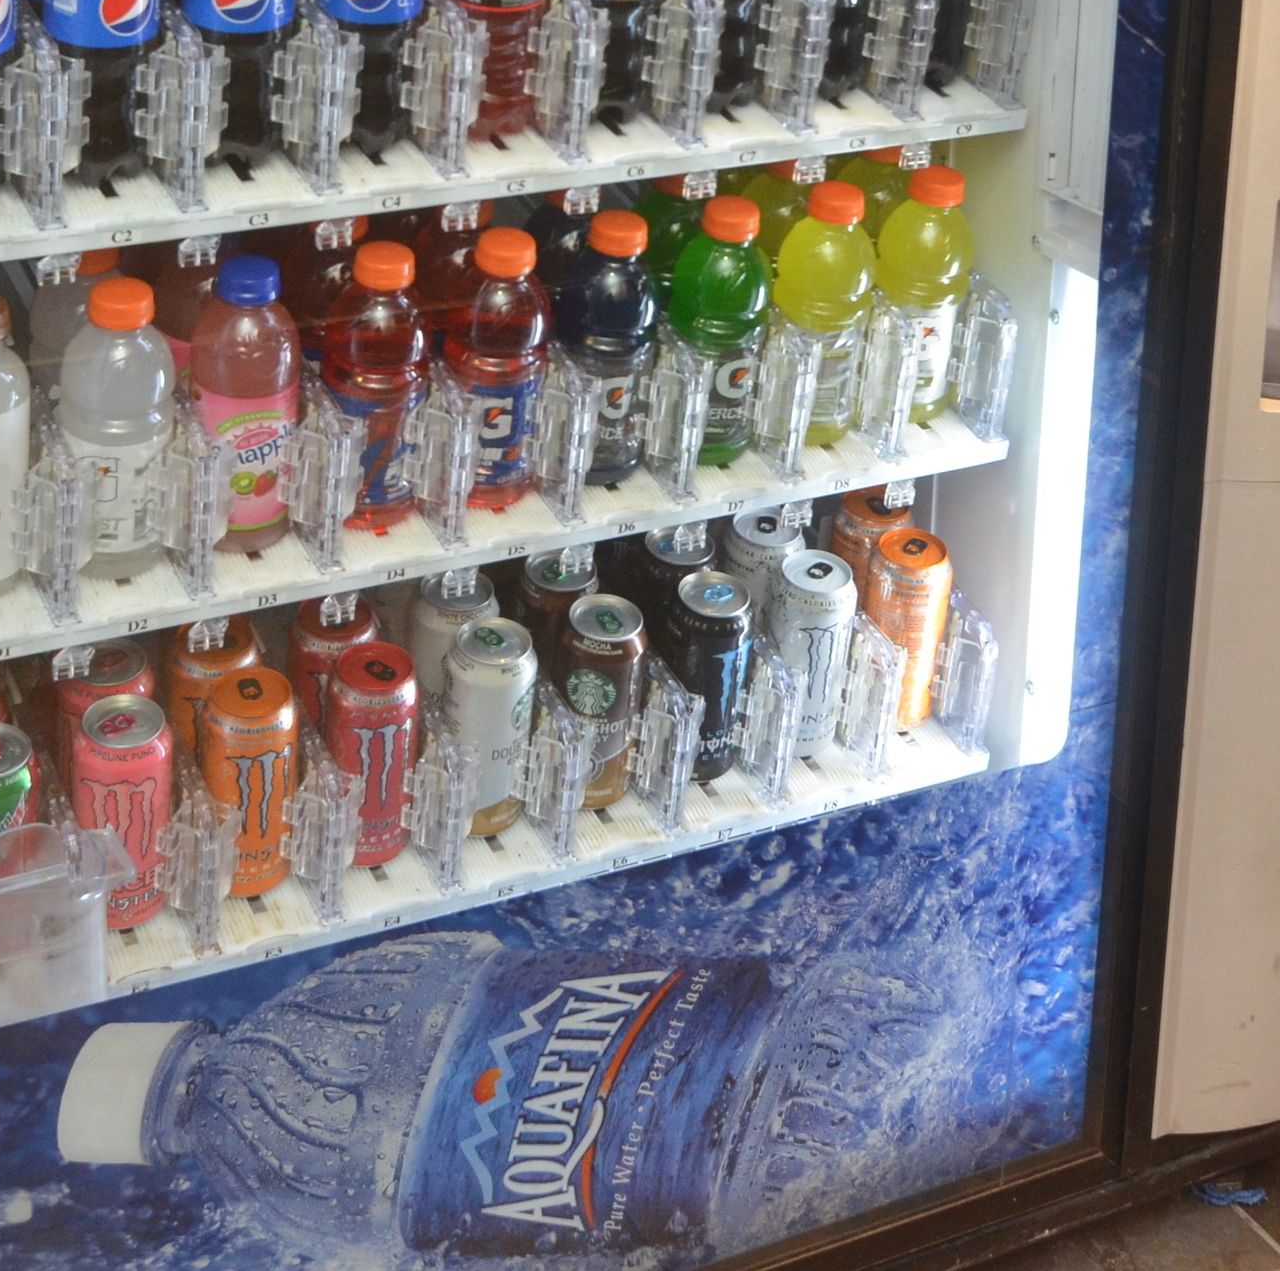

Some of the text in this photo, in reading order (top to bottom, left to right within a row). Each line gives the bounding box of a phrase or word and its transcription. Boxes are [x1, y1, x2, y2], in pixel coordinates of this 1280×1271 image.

[955, 123, 974, 136] C9
[848, 136, 867, 150] C8
[738, 149, 758, 163] C7
[626, 164, 646, 178] C6
[505, 180, 526, 193] C5
[381, 195, 402, 209] C4
[248, 213, 270, 227] C3
[110, 230, 133, 243] C2
[598, 374, 634, 420] G
[480, 397, 514, 440] G
[833, 479, 851, 491] D8
[727, 500, 745, 512] D7
[618, 520, 637, 533] D6
[385, 568, 407, 582] D4
[257, 594, 279, 608] D3
[127, 618, 149, 633] D2
[583, 637, 612, 651] MOCHA
[611, 855, 630, 868] E6
[497, 886, 516, 899] E5
[481, 966, 669, 1233] AQUAFINA
[603, 967, 713, 1236] Pure Water Perfect Taste
